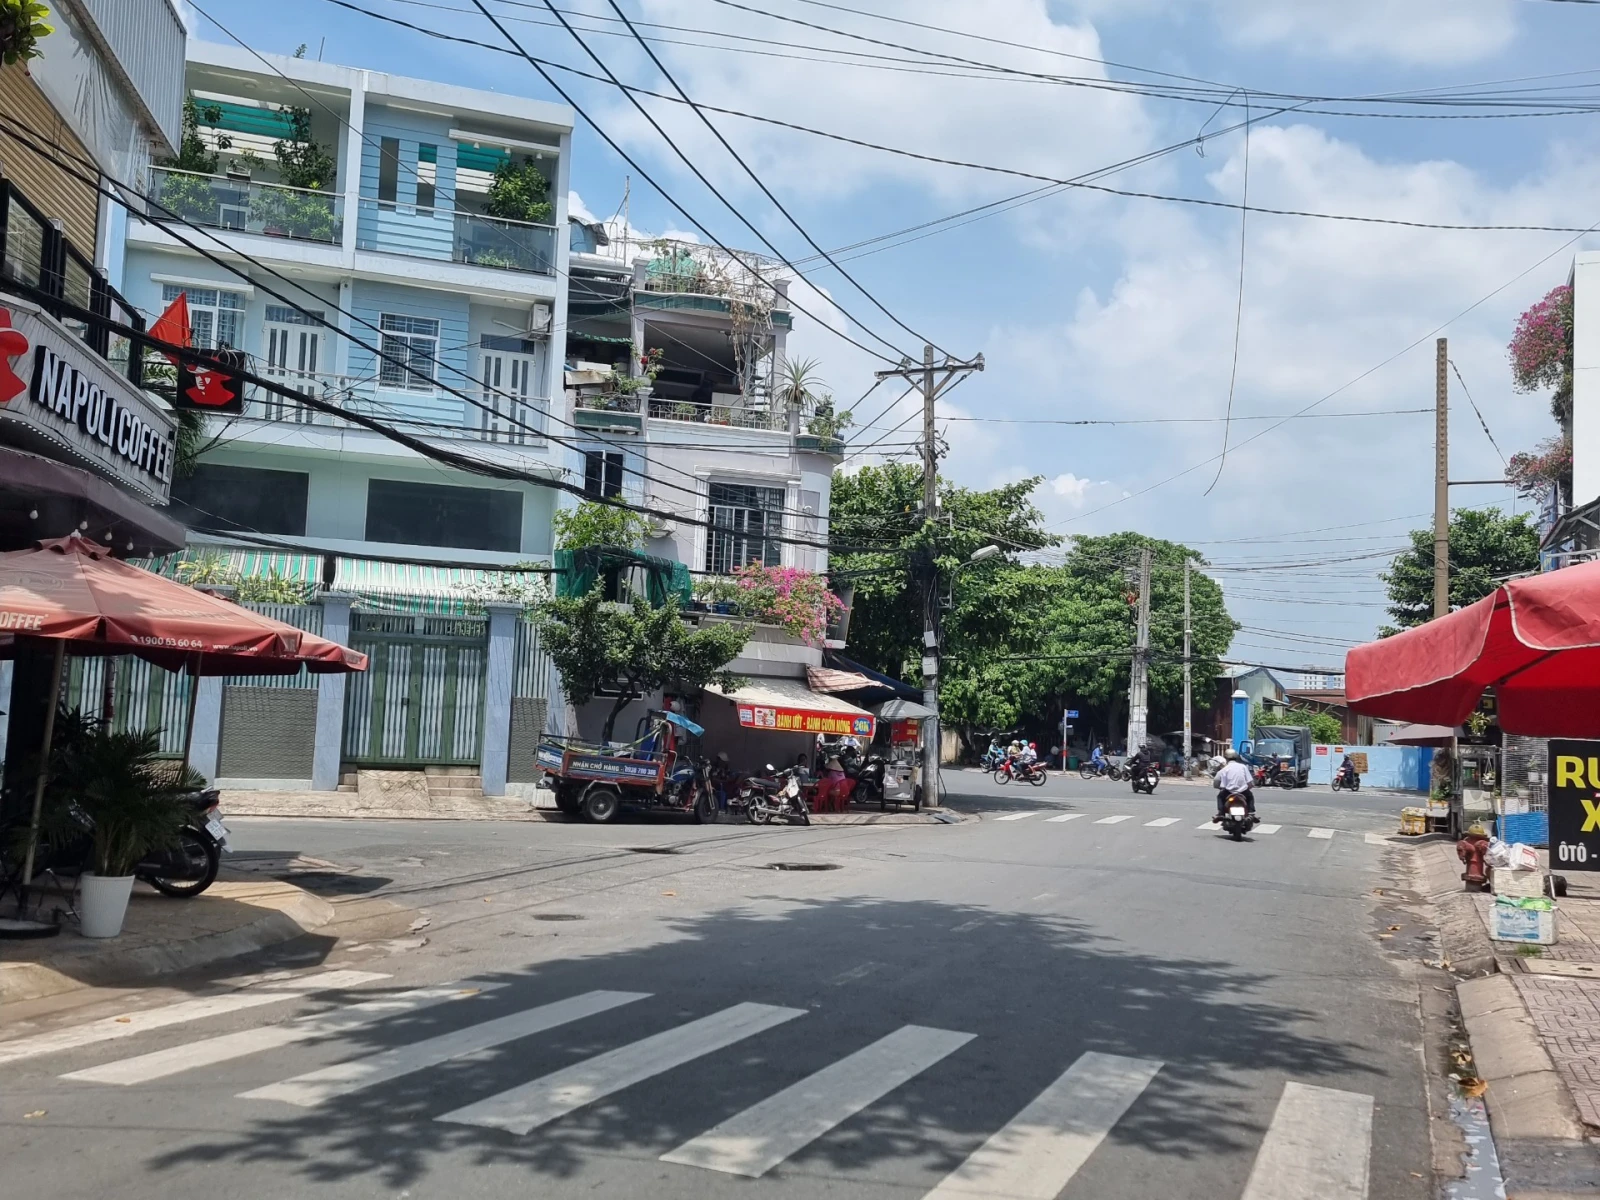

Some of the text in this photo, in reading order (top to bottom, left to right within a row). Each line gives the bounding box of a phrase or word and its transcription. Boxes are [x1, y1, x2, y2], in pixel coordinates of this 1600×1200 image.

[34, 345, 174, 485] NAPOLI COFFEE
[140, 636, 203, 649] 1900 63 60 64
[776, 711, 792, 728] BÁNH
[806, 714, 821, 730] BÁNH
[603, 764, 620, 772] HÀNG
[1558, 840, 1587, 863] ÔTÔ
